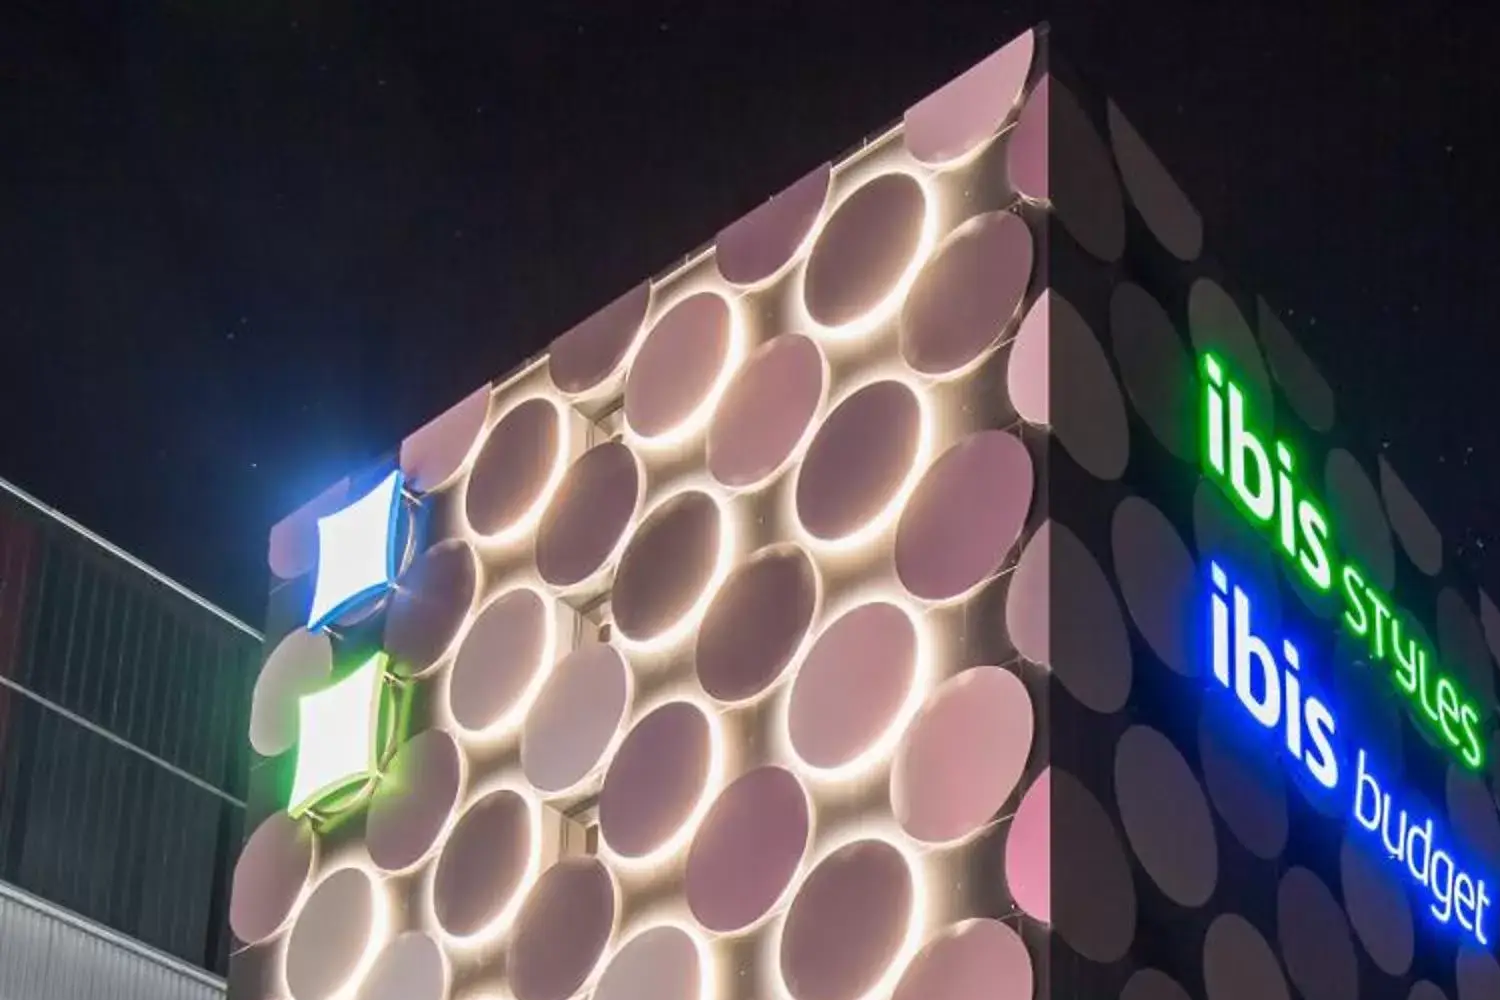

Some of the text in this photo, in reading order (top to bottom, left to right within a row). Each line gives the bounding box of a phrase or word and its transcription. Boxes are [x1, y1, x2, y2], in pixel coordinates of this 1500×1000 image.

[1206, 353, 1332, 590] ibis
[1210, 560, 1491, 946] ibis budget
